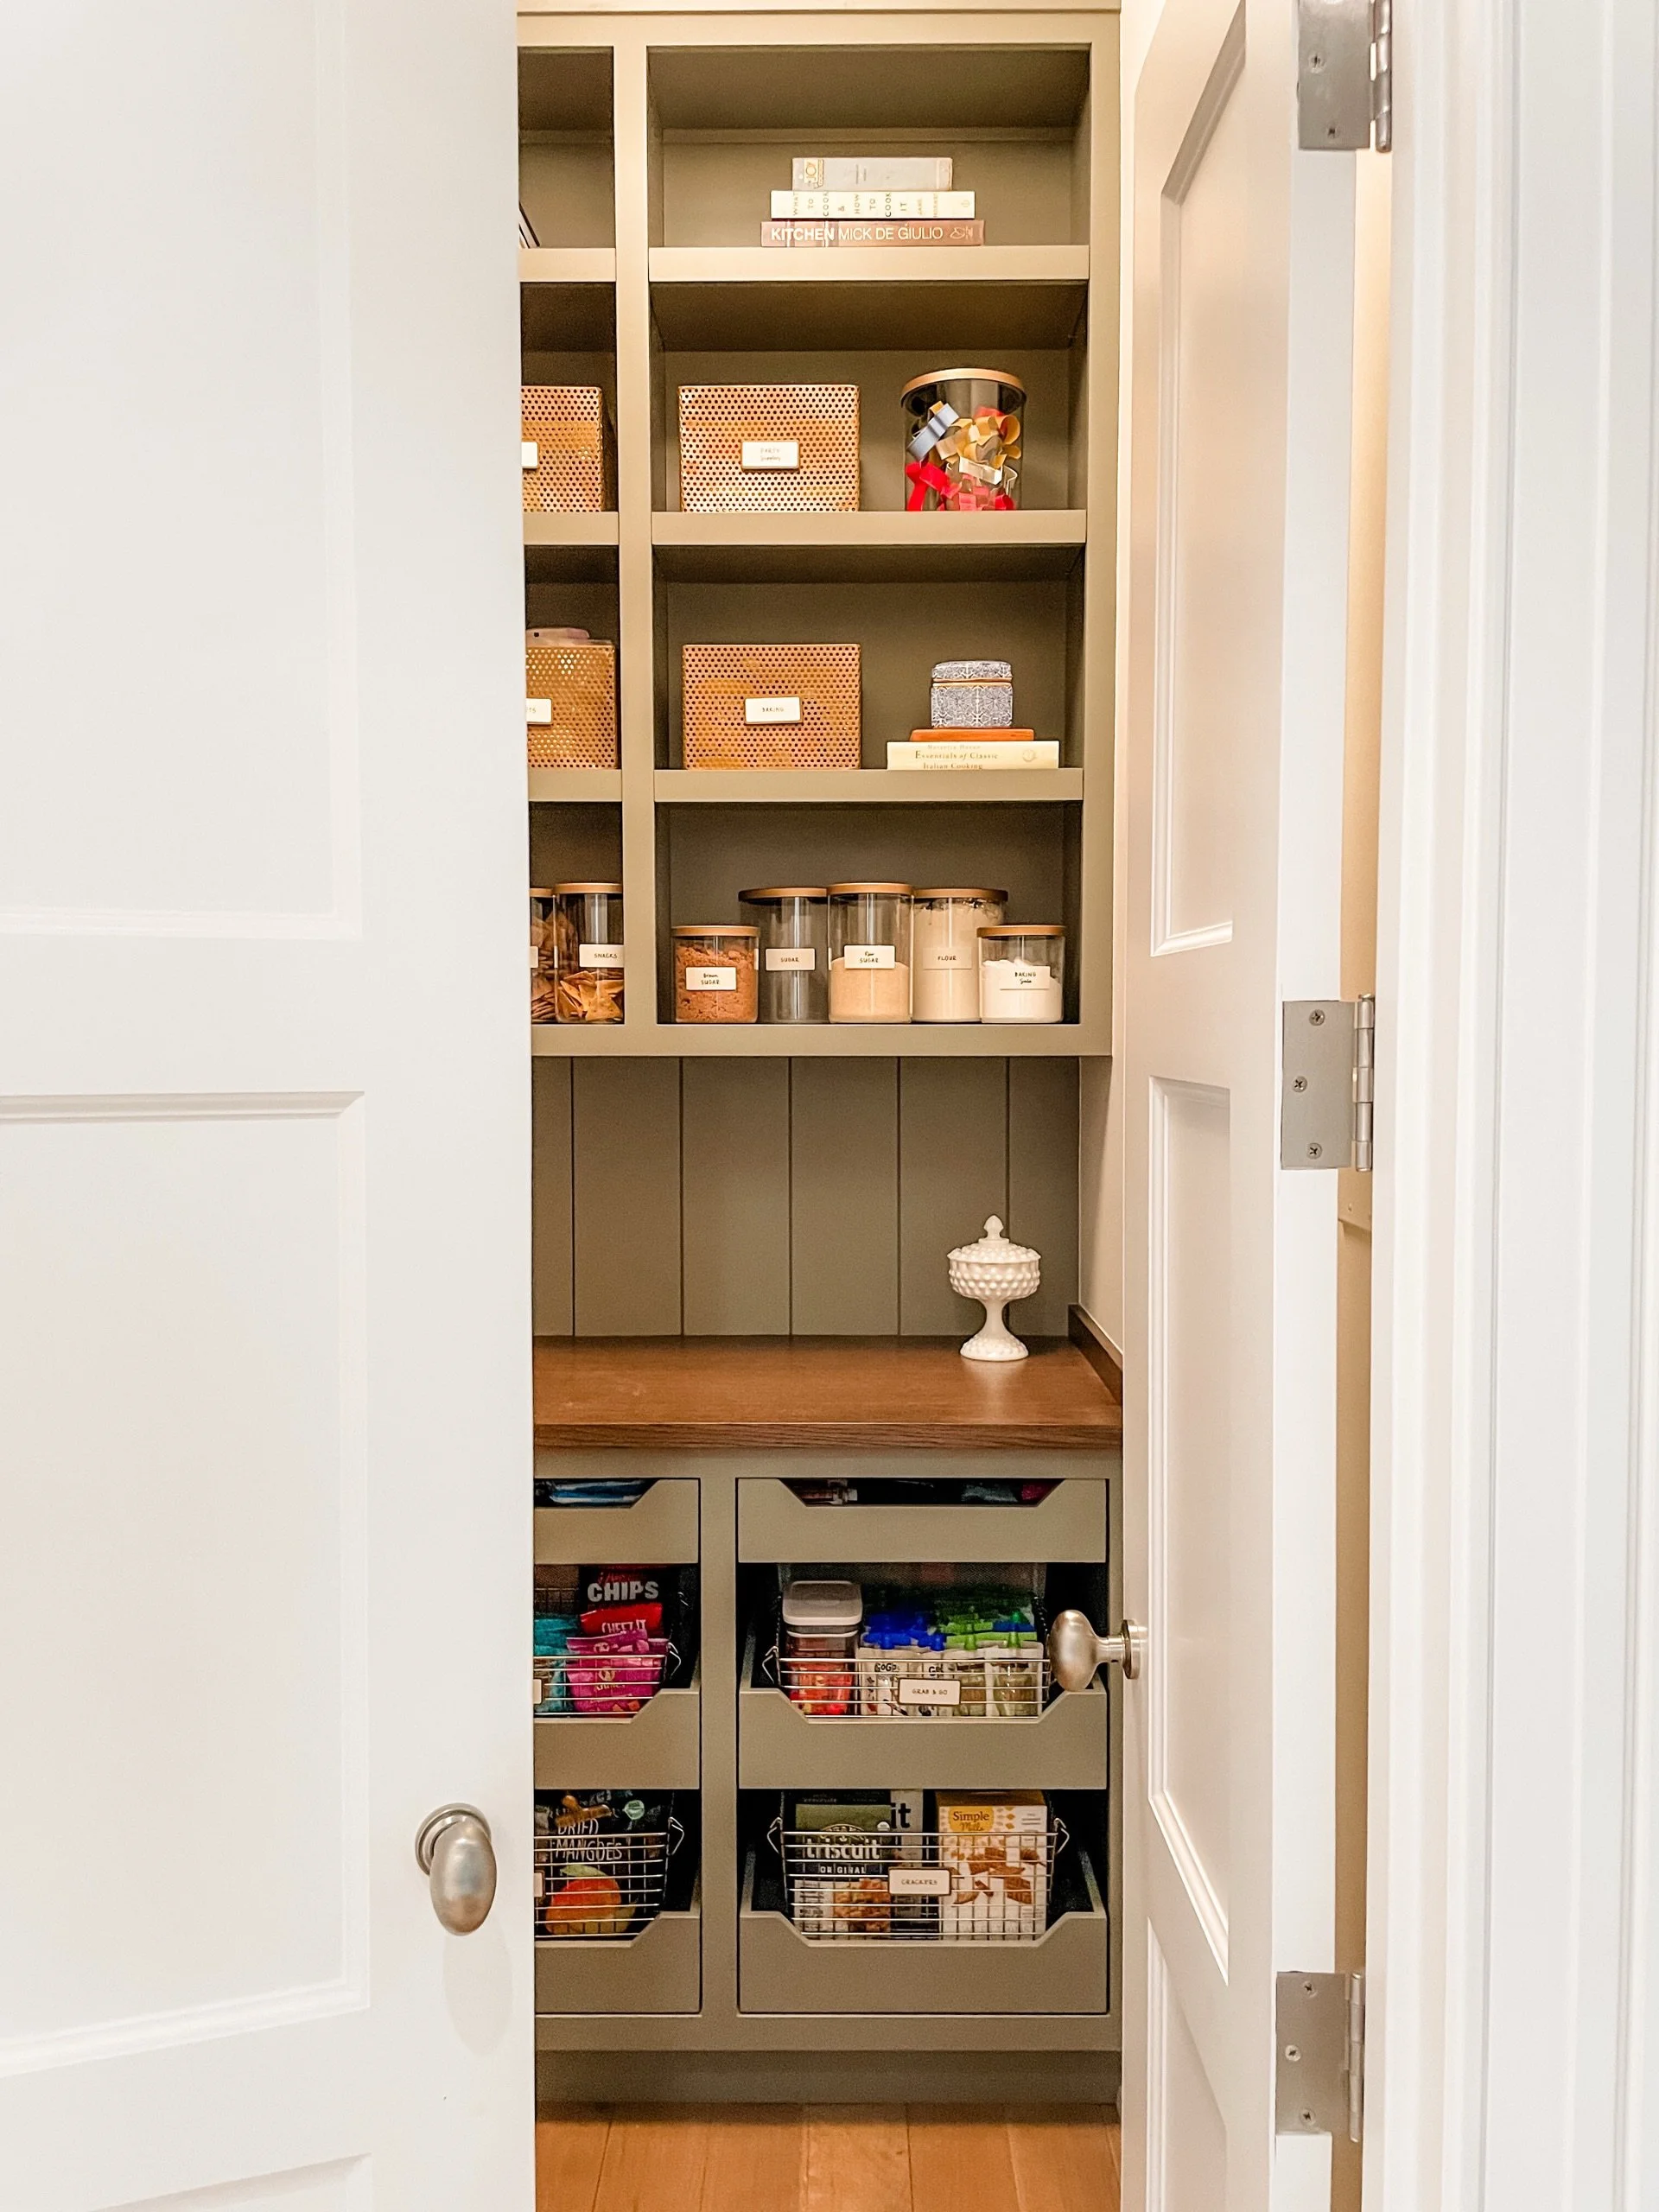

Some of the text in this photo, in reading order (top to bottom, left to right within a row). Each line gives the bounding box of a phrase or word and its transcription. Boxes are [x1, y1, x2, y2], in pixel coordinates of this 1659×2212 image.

[771, 225, 944, 241] KITCHEN MICK DE GIULIO
[915, 750, 957, 760] Essentials
[959, 752, 968, 760] of
[587, 1580, 659, 1603] CHIPS
[952, 1810, 989, 1823] Simple
[555, 1836, 623, 1862] MANGOES
[806, 1838, 880, 1859] triscuit
[820, 1866, 867, 1874] ORGINAL
